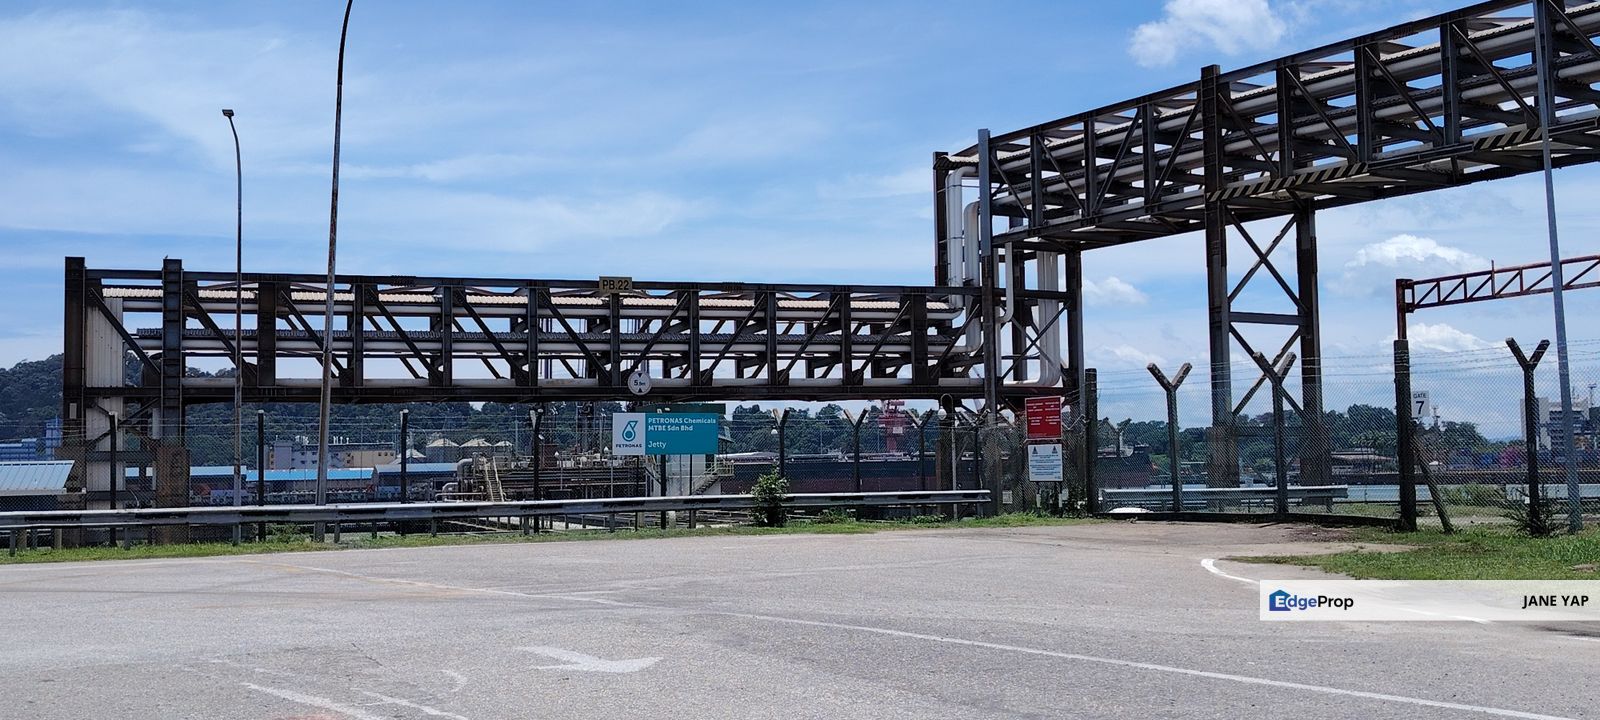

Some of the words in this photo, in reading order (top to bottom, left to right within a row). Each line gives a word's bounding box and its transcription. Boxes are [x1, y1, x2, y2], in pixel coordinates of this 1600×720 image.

[602, 279, 630, 290] PB.22
[1415, 400, 1425, 415] 7
[647, 440, 667, 449] Jetty
